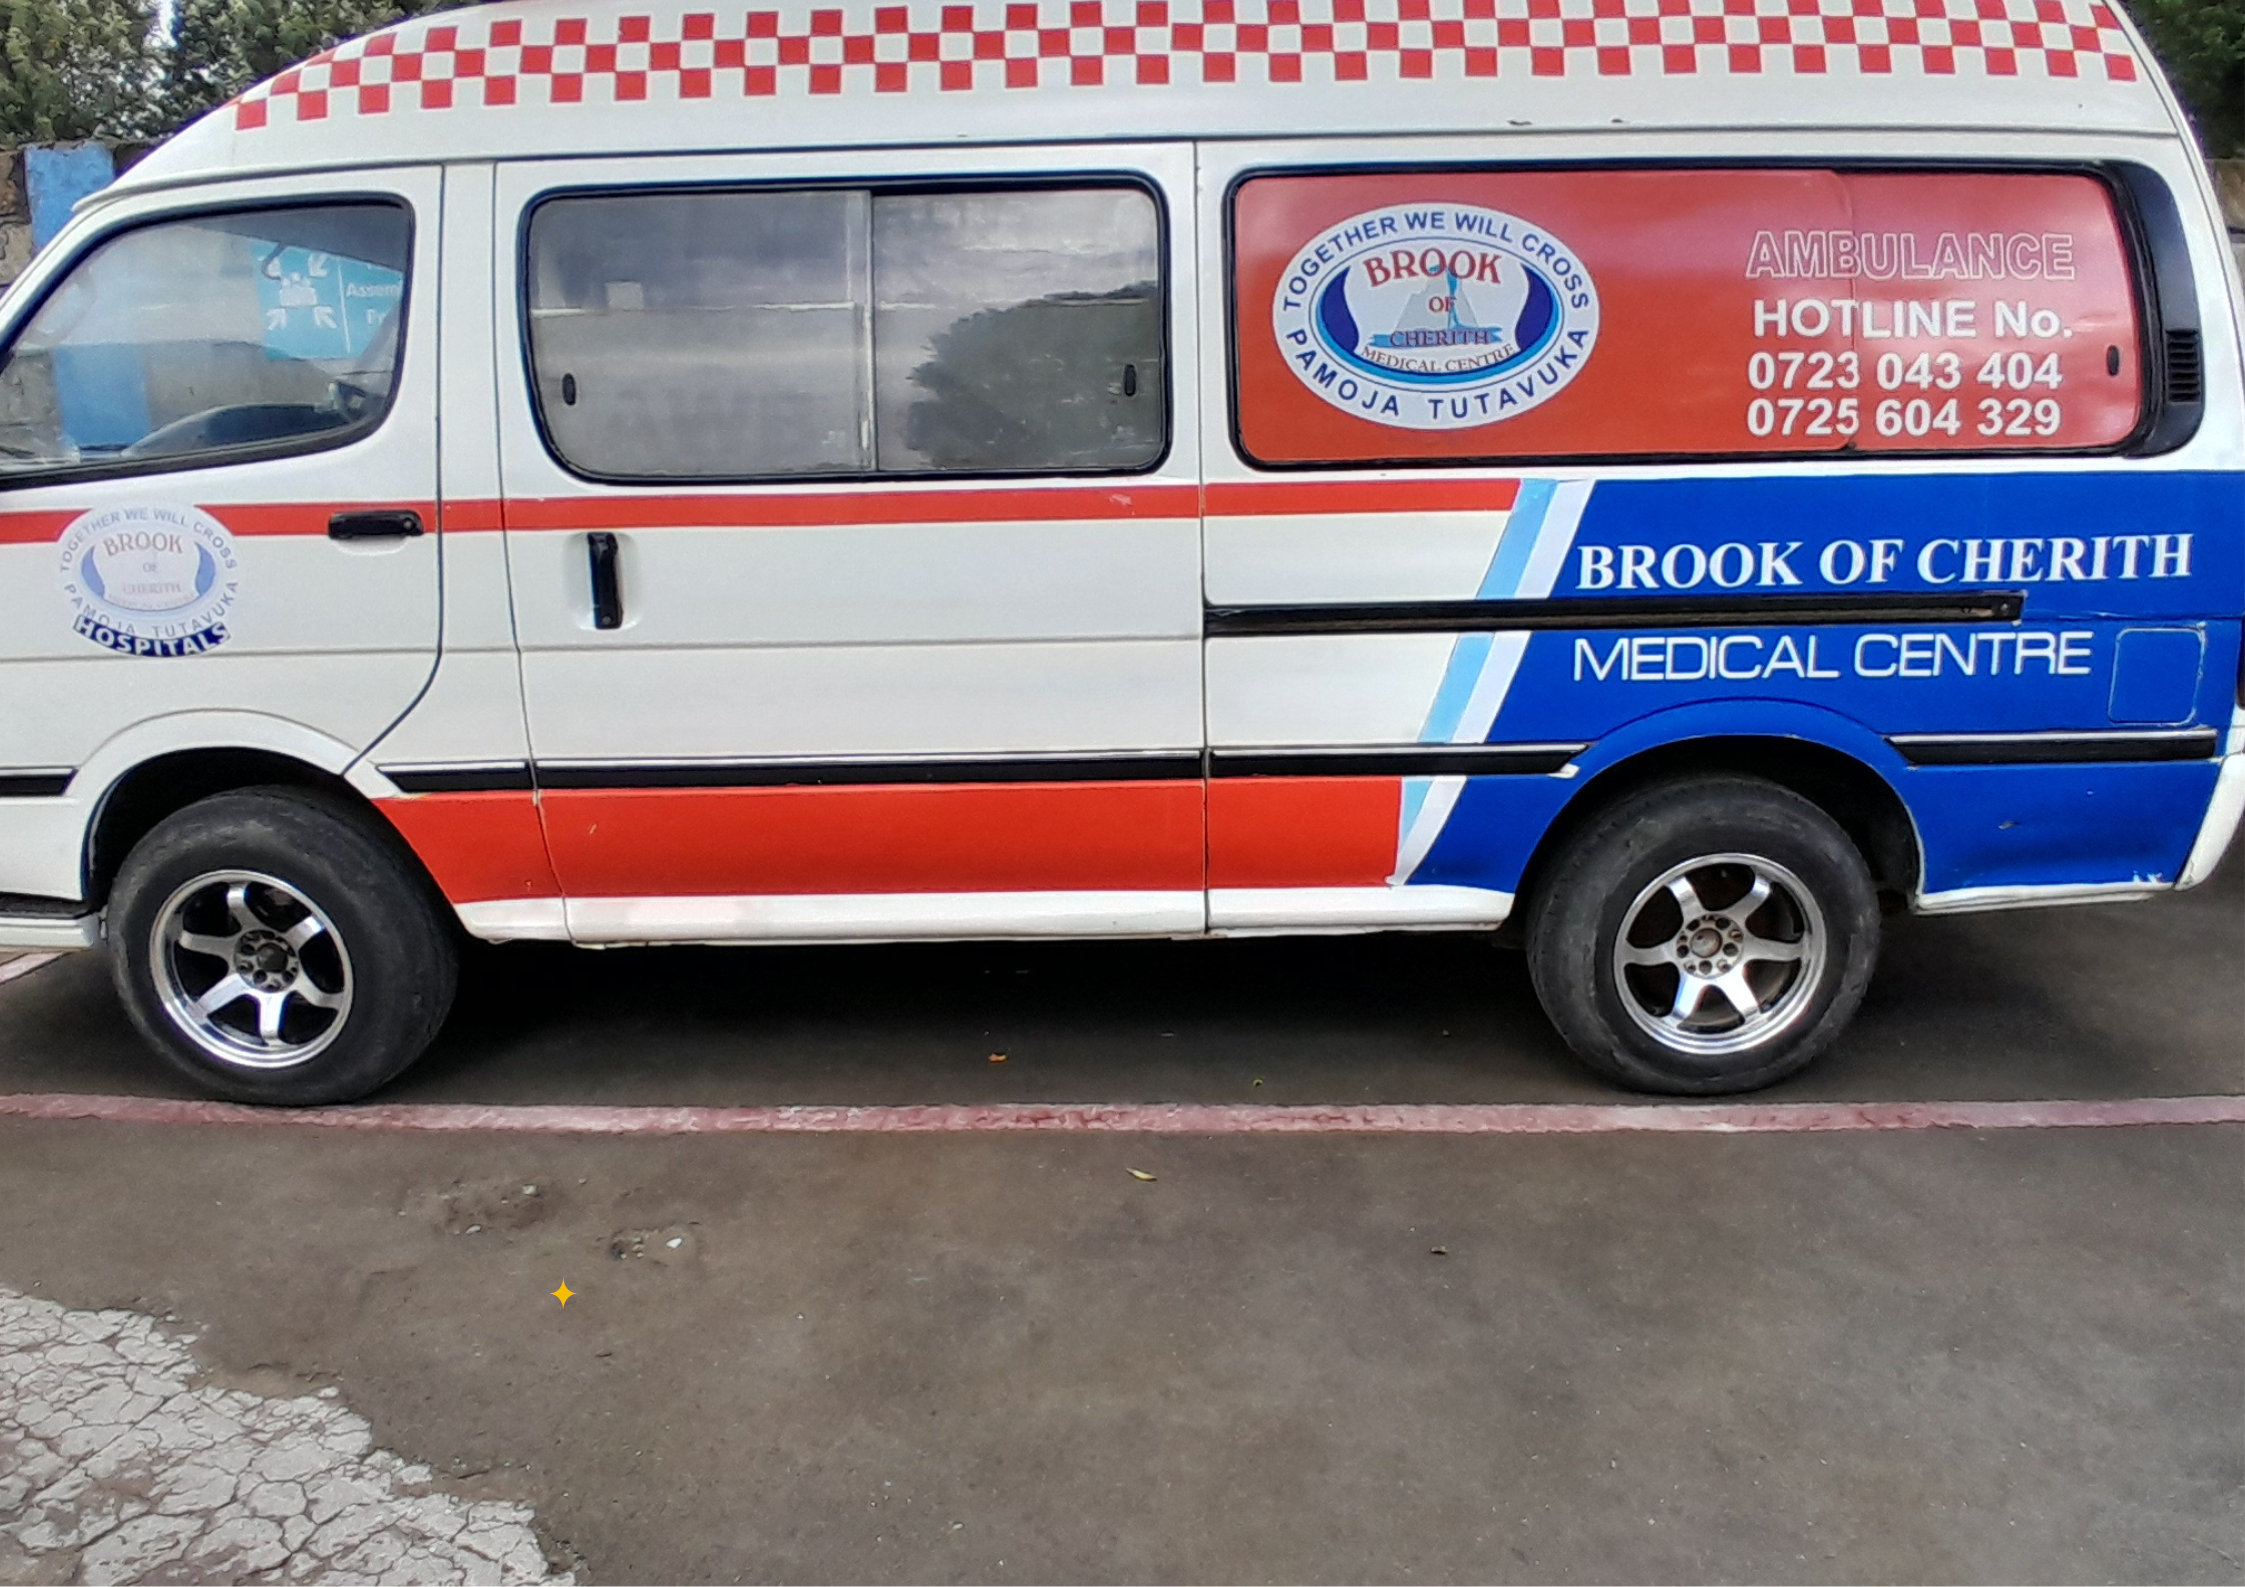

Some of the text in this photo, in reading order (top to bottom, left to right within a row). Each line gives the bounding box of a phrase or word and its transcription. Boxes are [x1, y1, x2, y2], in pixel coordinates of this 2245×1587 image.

[1283, 211, 1590, 312] TOGETHER WE WILL CROSS
[1363, 247, 1503, 287] BROOK
[1745, 231, 2075, 280] AMBULANCE
[346, 283, 401, 298] Assem
[1428, 296, 1457, 313] OF
[1389, 329, 1491, 347] CHERITH
[1753, 300, 2073, 338] HOTLINE No.
[1286, 328, 1589, 420] PAMOJA TUTAVUKA
[1360, 344, 1516, 373] MEDICAL CENTRE
[1747, 351, 2063, 390] 0723 043 404
[1746, 399, 2061, 436] 0725 604 329
[60, 507, 237, 573] TOGETHER WE WILL CROSS
[102, 531, 183, 557] BROOK
[142, 562, 158, 573] OF
[1576, 533, 2194, 590] BROOK OF CHERITH
[64, 581, 239, 638] PAMOJA TUTAVUKA
[75, 615, 229, 656] HOSPITALS
[1574, 631, 2093, 681] MEDICAL CENTRE
